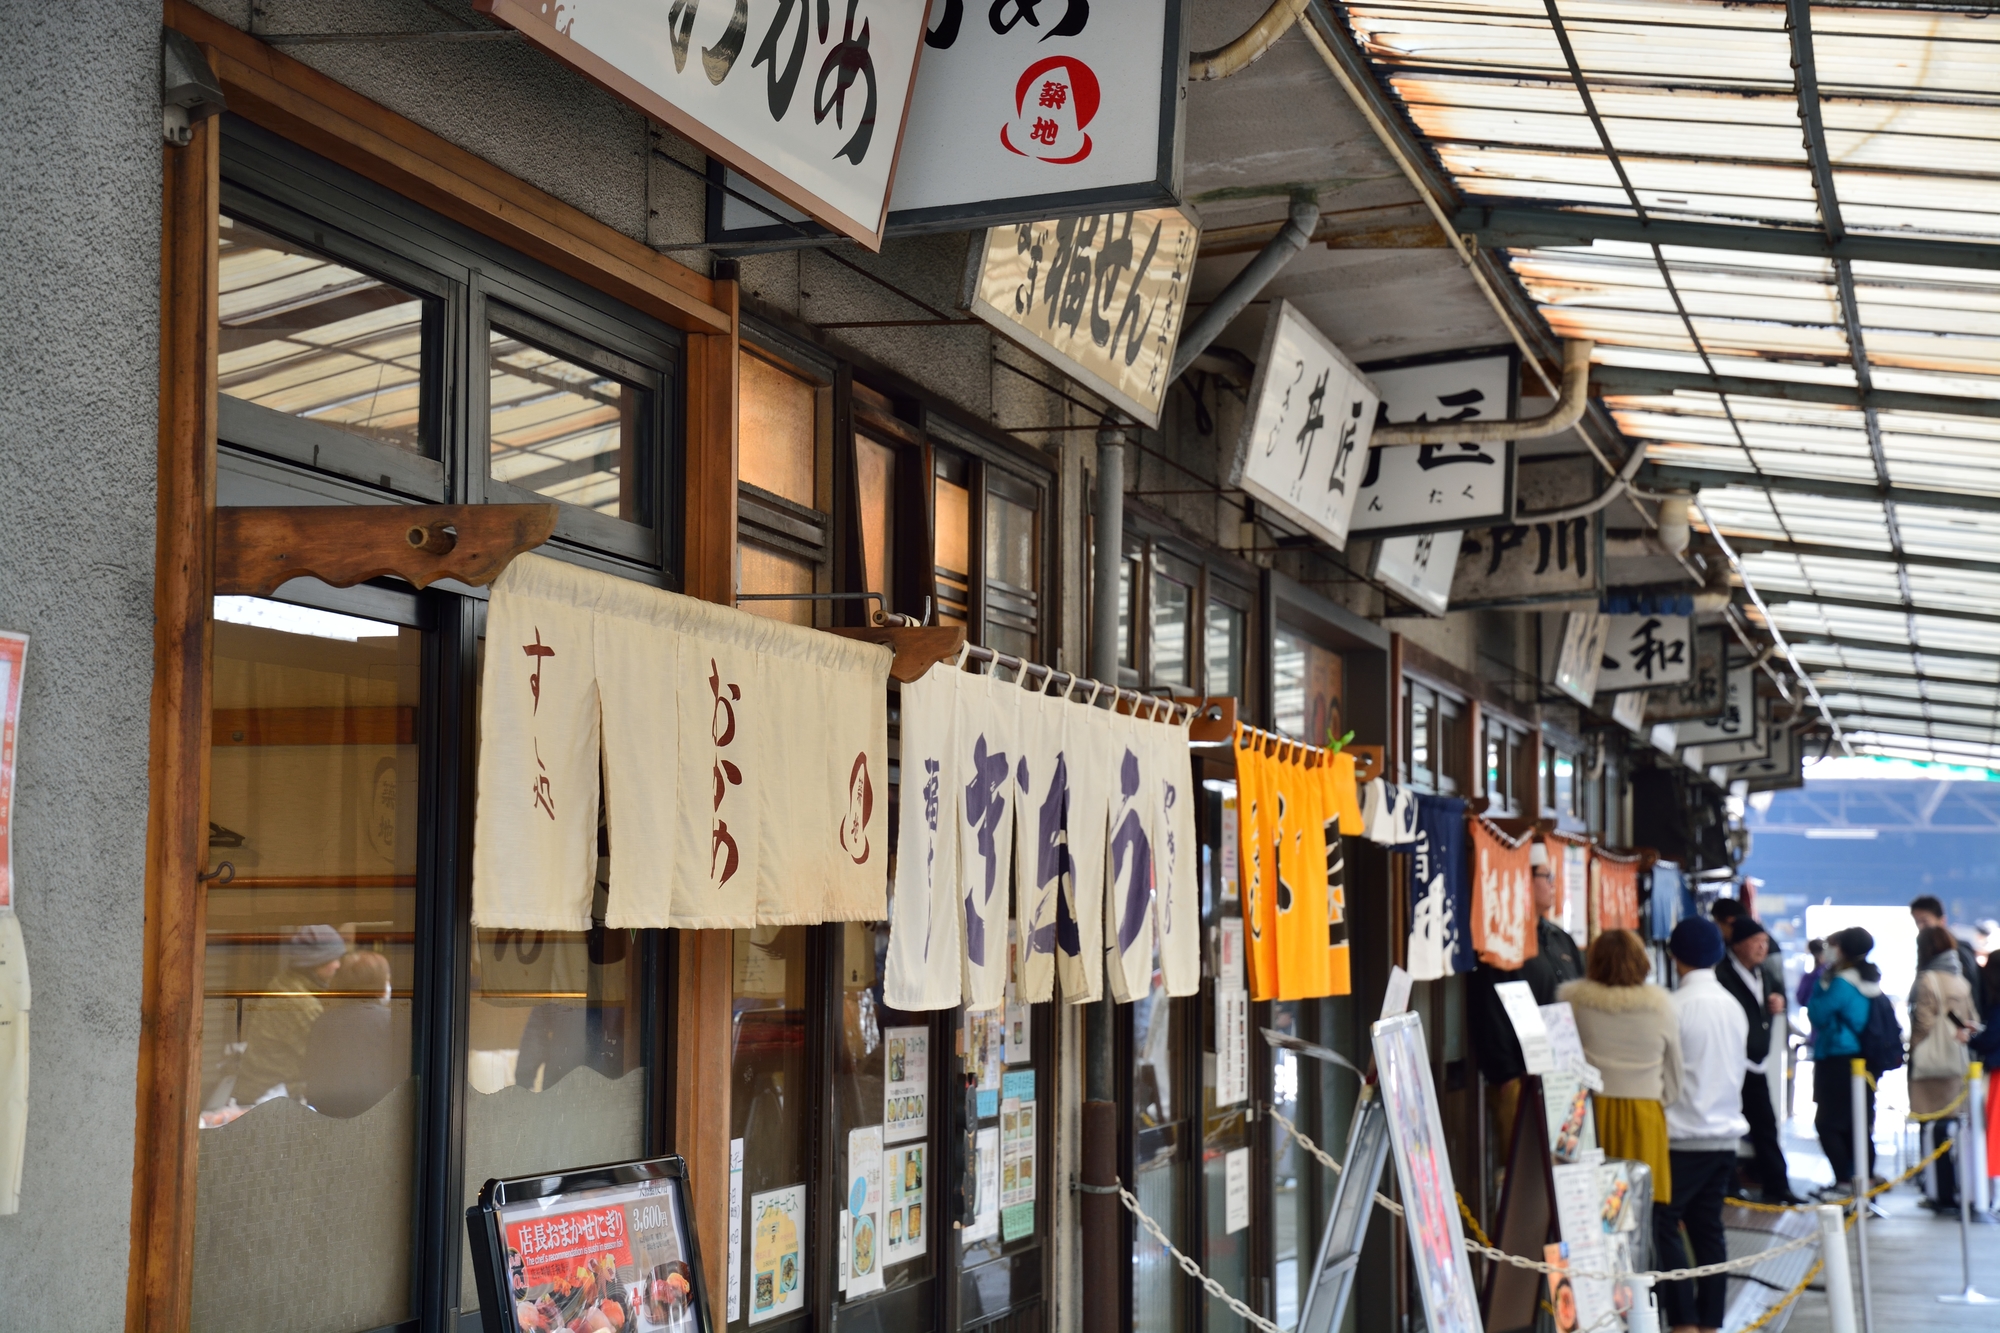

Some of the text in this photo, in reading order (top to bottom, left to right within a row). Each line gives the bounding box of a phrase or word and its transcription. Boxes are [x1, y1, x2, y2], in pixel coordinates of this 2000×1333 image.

[1029, 80, 1068, 146] 築地
[708, 657, 742, 890] おかめ
[633, 1204, 668, 1233] 3,600円
[755, 1192, 798, 1222] ランチサービス
[518, 1209, 625, 1256] 店長おまかせにぎり
[526, 1256, 535, 1266] The
[535, 1253, 549, 1265] chef's
[549, 1249, 583, 1261] recommendation
[588, 1246, 599, 1256] sushi
[604, 1243, 616, 1251] season
